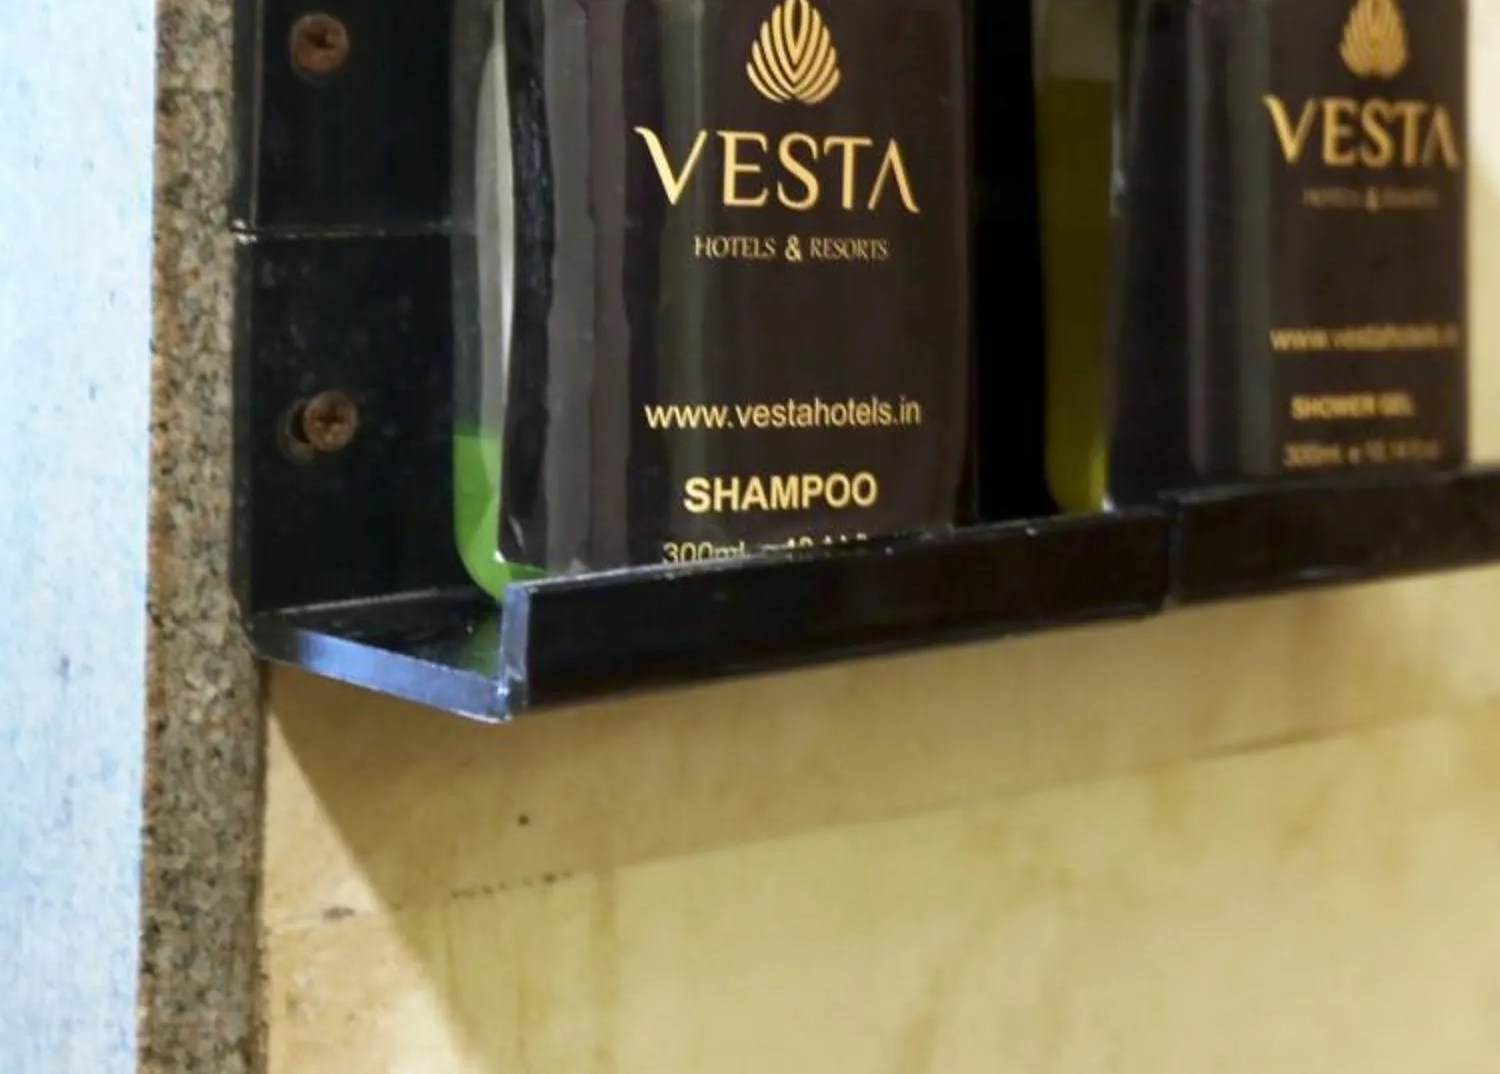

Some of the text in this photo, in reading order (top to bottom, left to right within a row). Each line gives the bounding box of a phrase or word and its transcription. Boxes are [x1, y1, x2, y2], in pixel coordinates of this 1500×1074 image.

[1262, 94, 1461, 170] VESTA
[633, 126, 921, 214] VESTA
[694, 235, 889, 263] HOTELS & RESORTS
[644, 394, 922, 428] www.vestahotels.in
[683, 472, 878, 514] SHAMPOO
